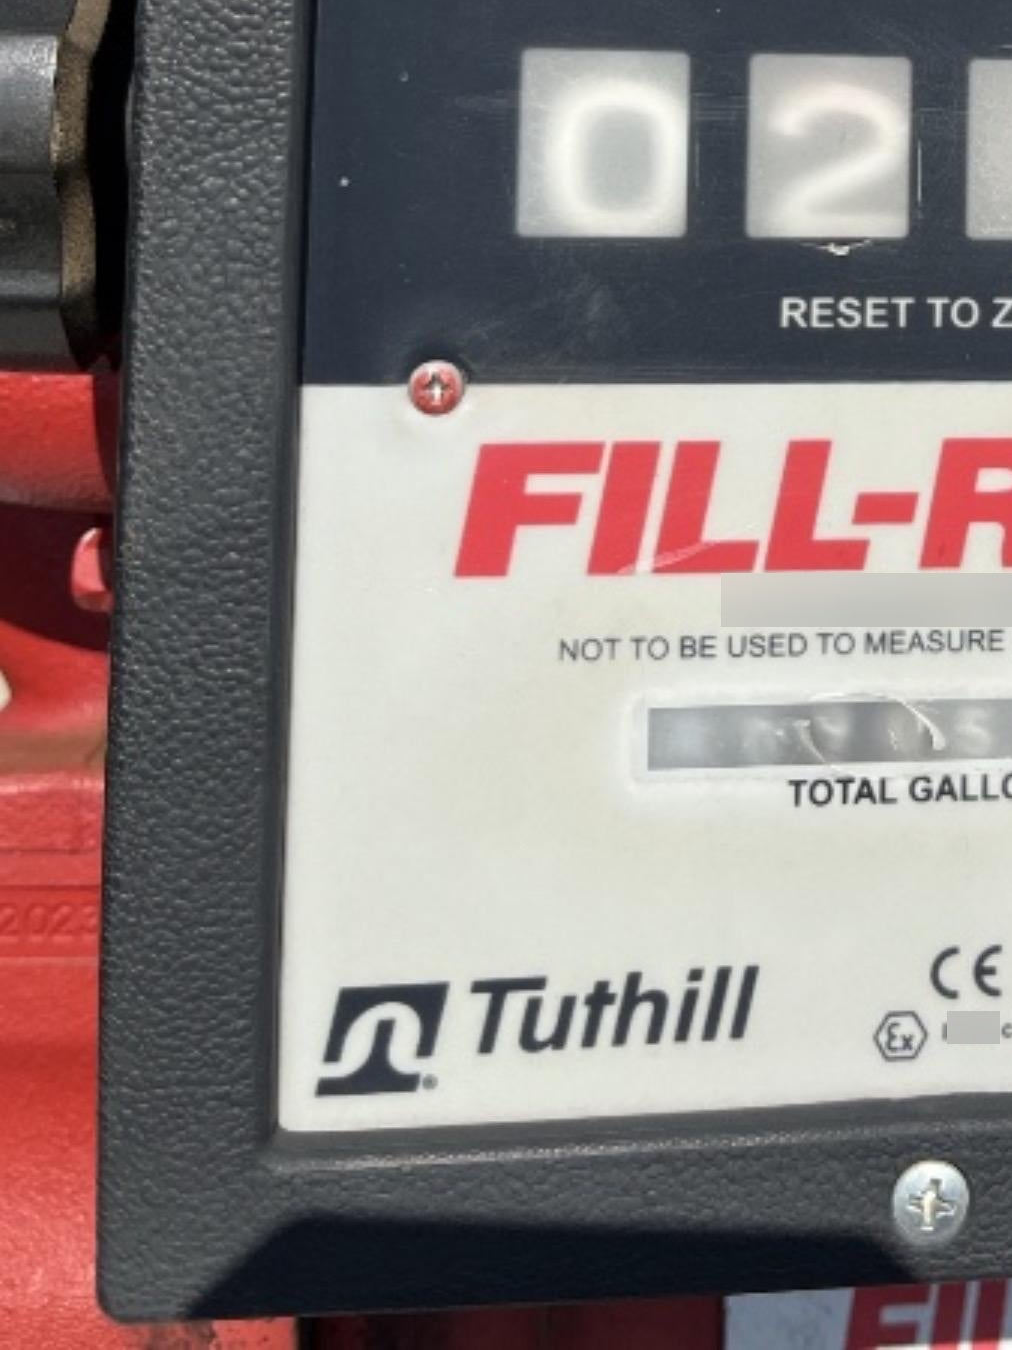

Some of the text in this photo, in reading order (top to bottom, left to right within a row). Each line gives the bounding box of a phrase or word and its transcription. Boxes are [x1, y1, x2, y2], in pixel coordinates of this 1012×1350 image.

[780, 296, 916, 329] RESET
[927, 296, 980, 328] TO
[558, 637, 622, 662] NOT
[629, 635, 671, 661] TO
[679, 634, 719, 659] BE
[726, 632, 808, 658] USED
[815, 630, 856, 656] TO
[863, 628, 1007, 655] MEASURE
[787, 775, 899, 808] TOTAL
[929, 942, 1004, 1000] CE
[469, 964, 760, 1055] Tuthill
